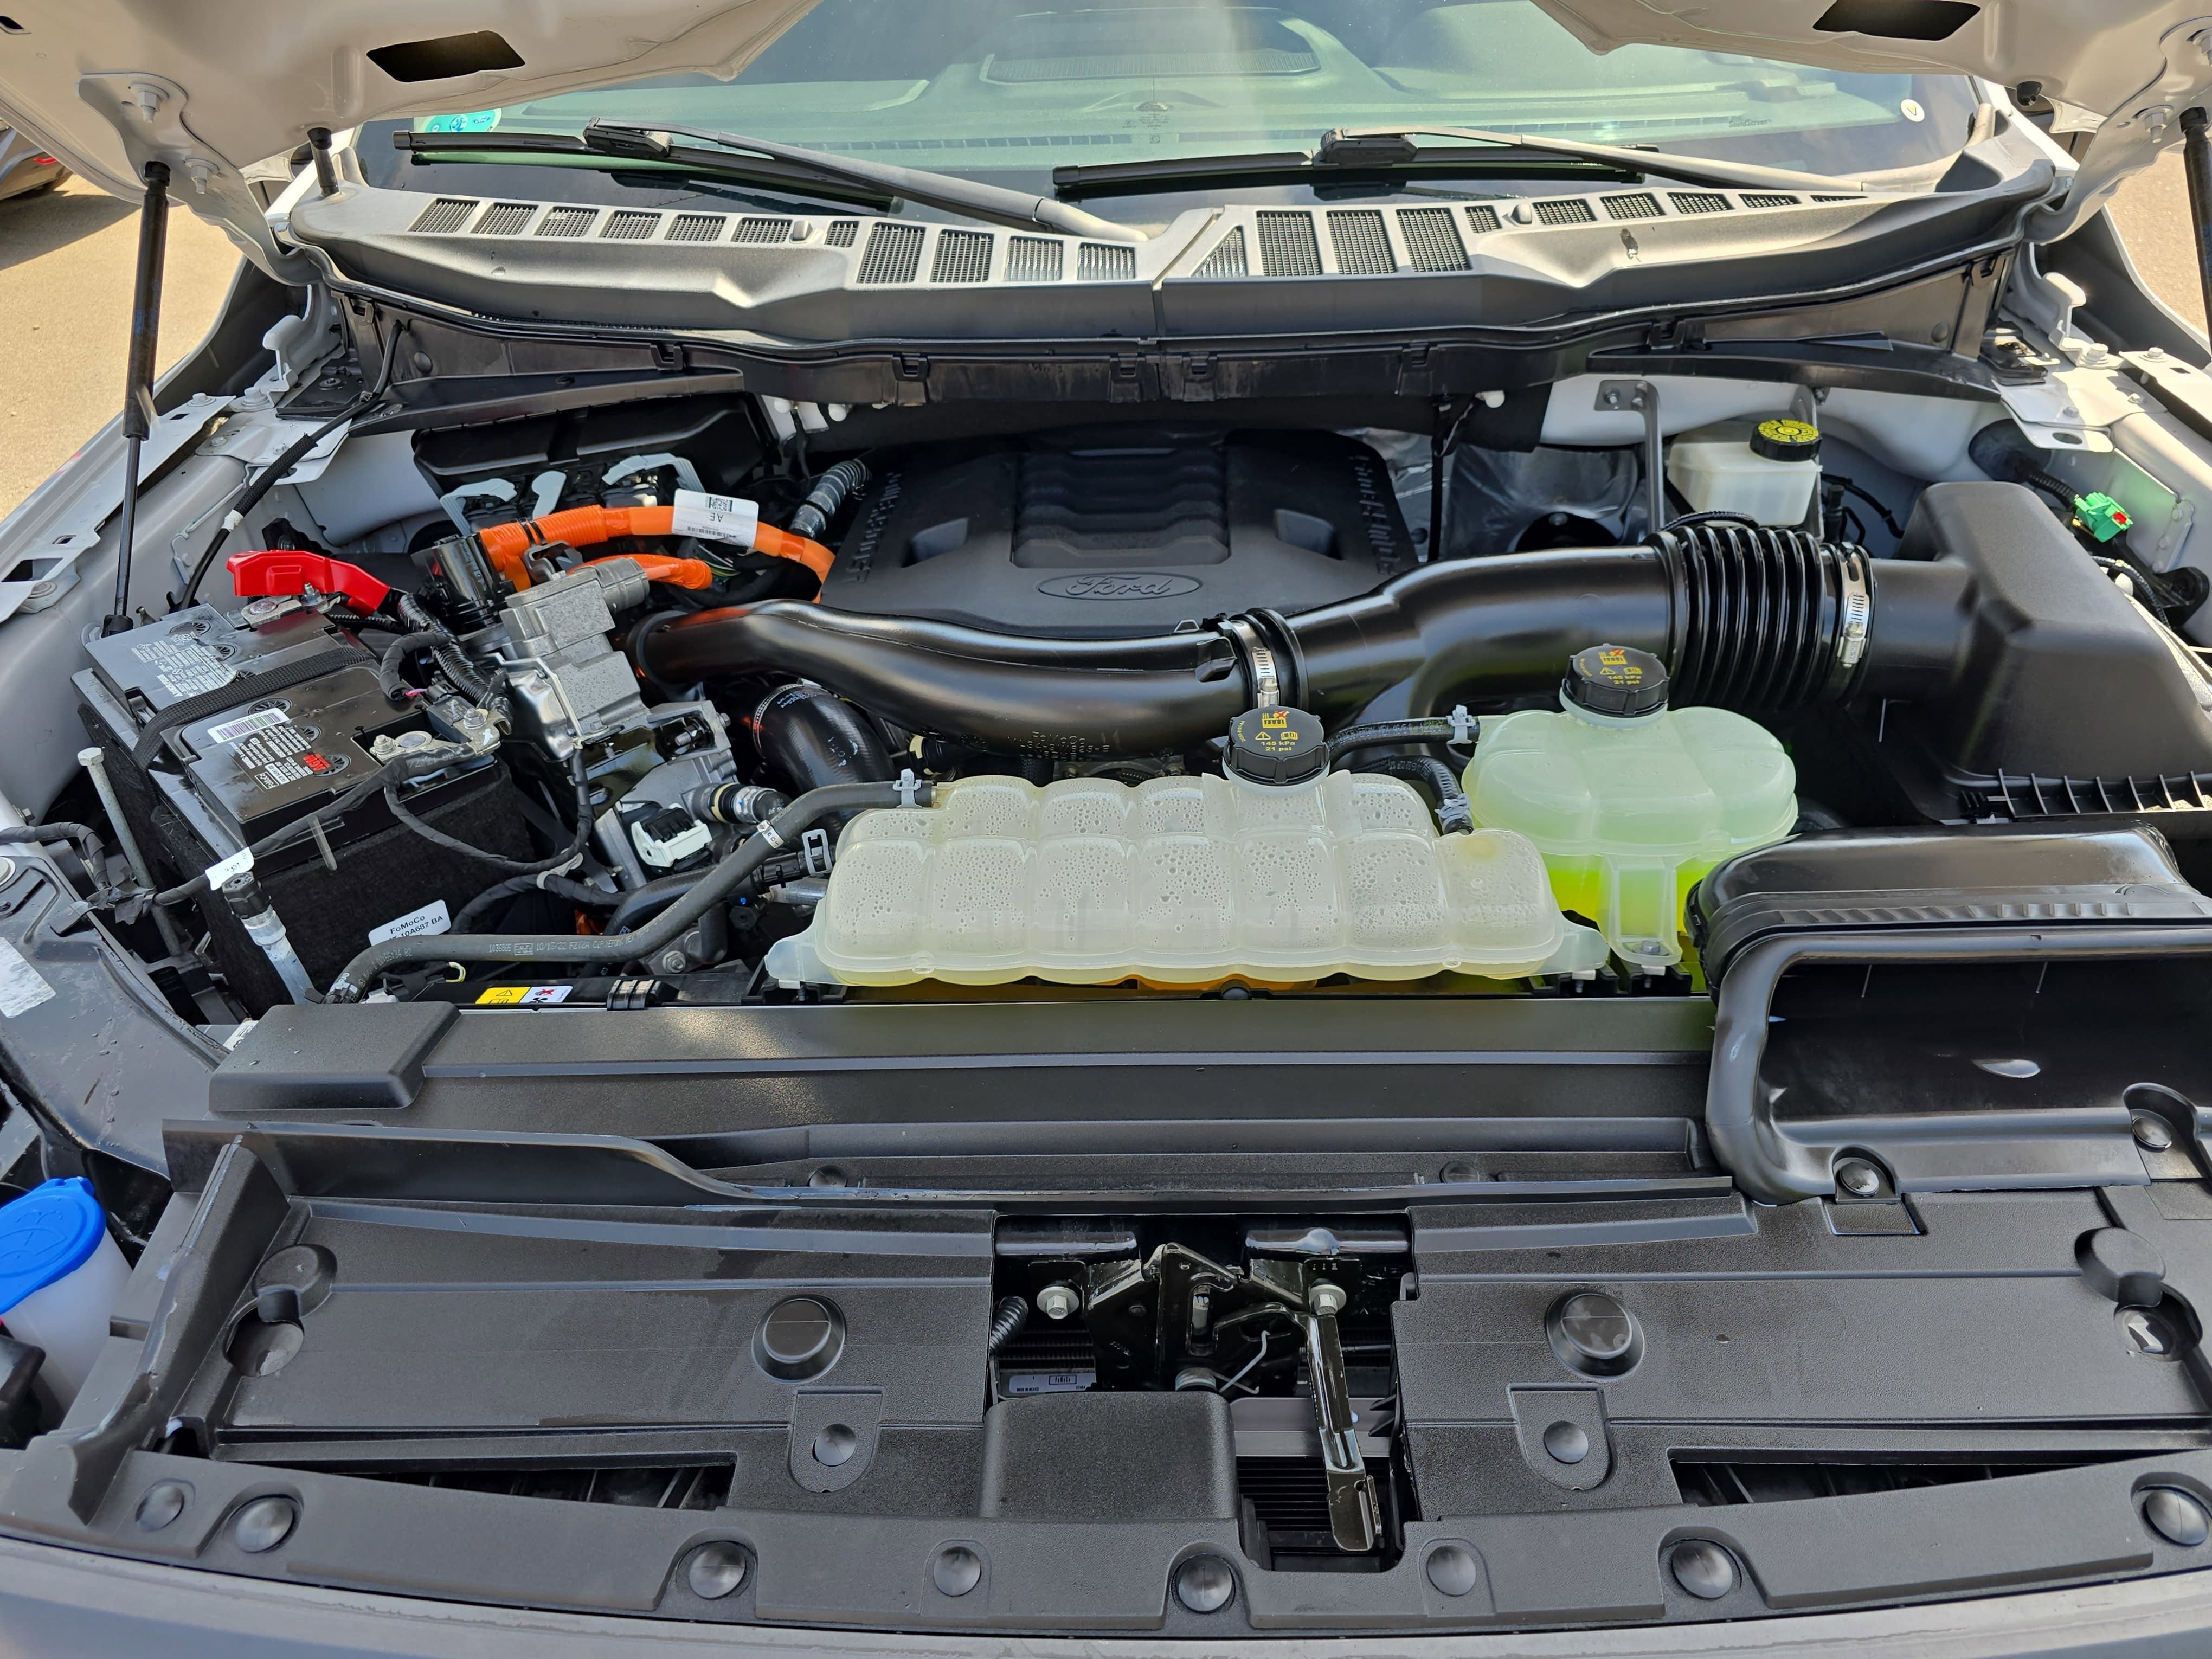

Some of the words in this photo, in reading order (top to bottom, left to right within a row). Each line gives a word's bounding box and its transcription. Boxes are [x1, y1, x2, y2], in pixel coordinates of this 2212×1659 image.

[709, 512, 724, 523] AE
[1066, 575, 1173, 595] Ford
[390, 916, 426, 935] FoMoCo
[401, 922, 429, 937] 10A687
[431, 916, 444, 925] BA
